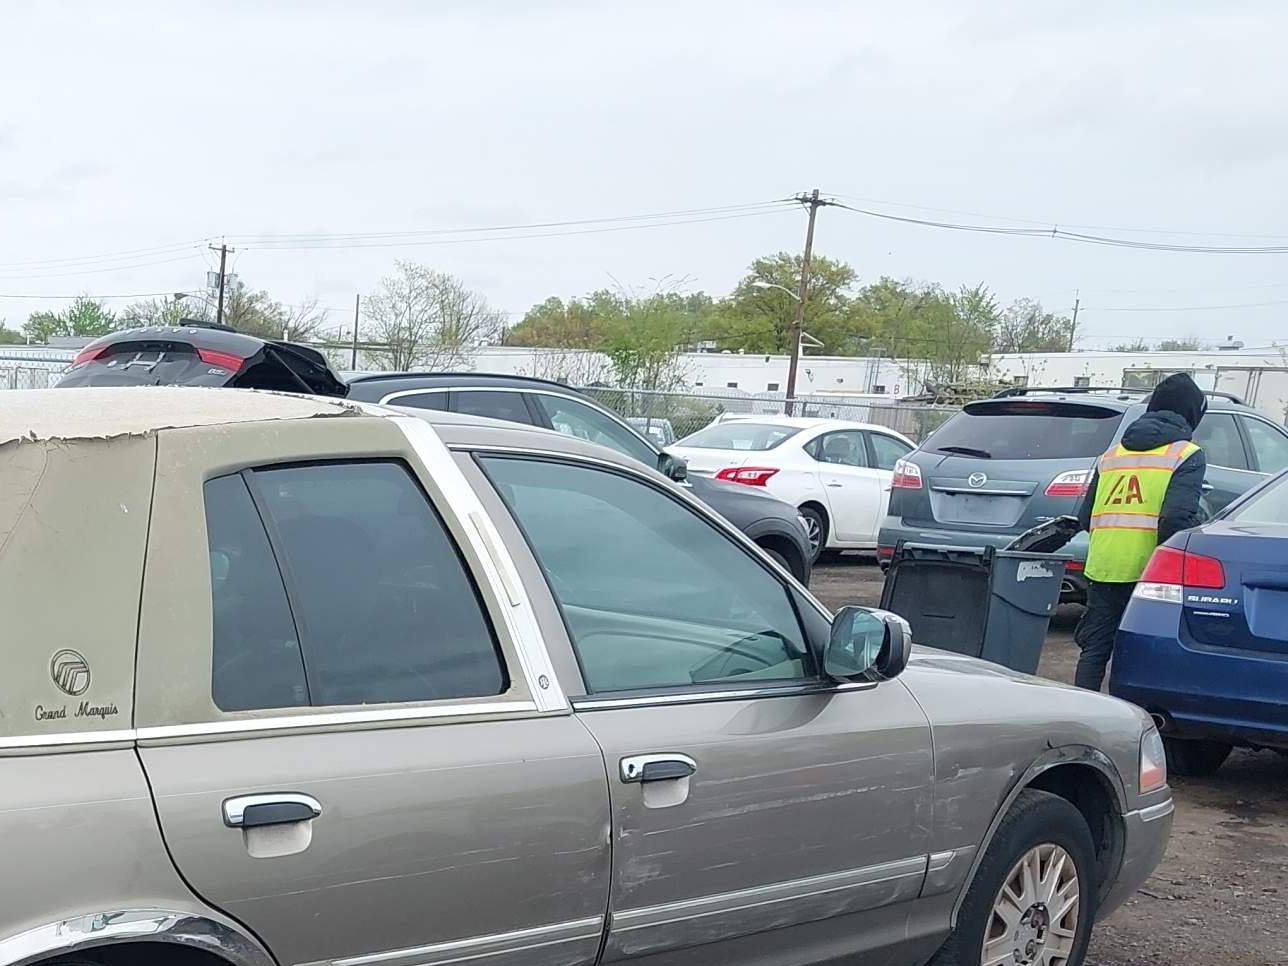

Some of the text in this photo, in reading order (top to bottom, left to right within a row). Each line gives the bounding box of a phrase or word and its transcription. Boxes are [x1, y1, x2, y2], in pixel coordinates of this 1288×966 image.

[1187, 595, 1239, 605] SUBARU
[35, 701, 118, 721] Grand Marquis
